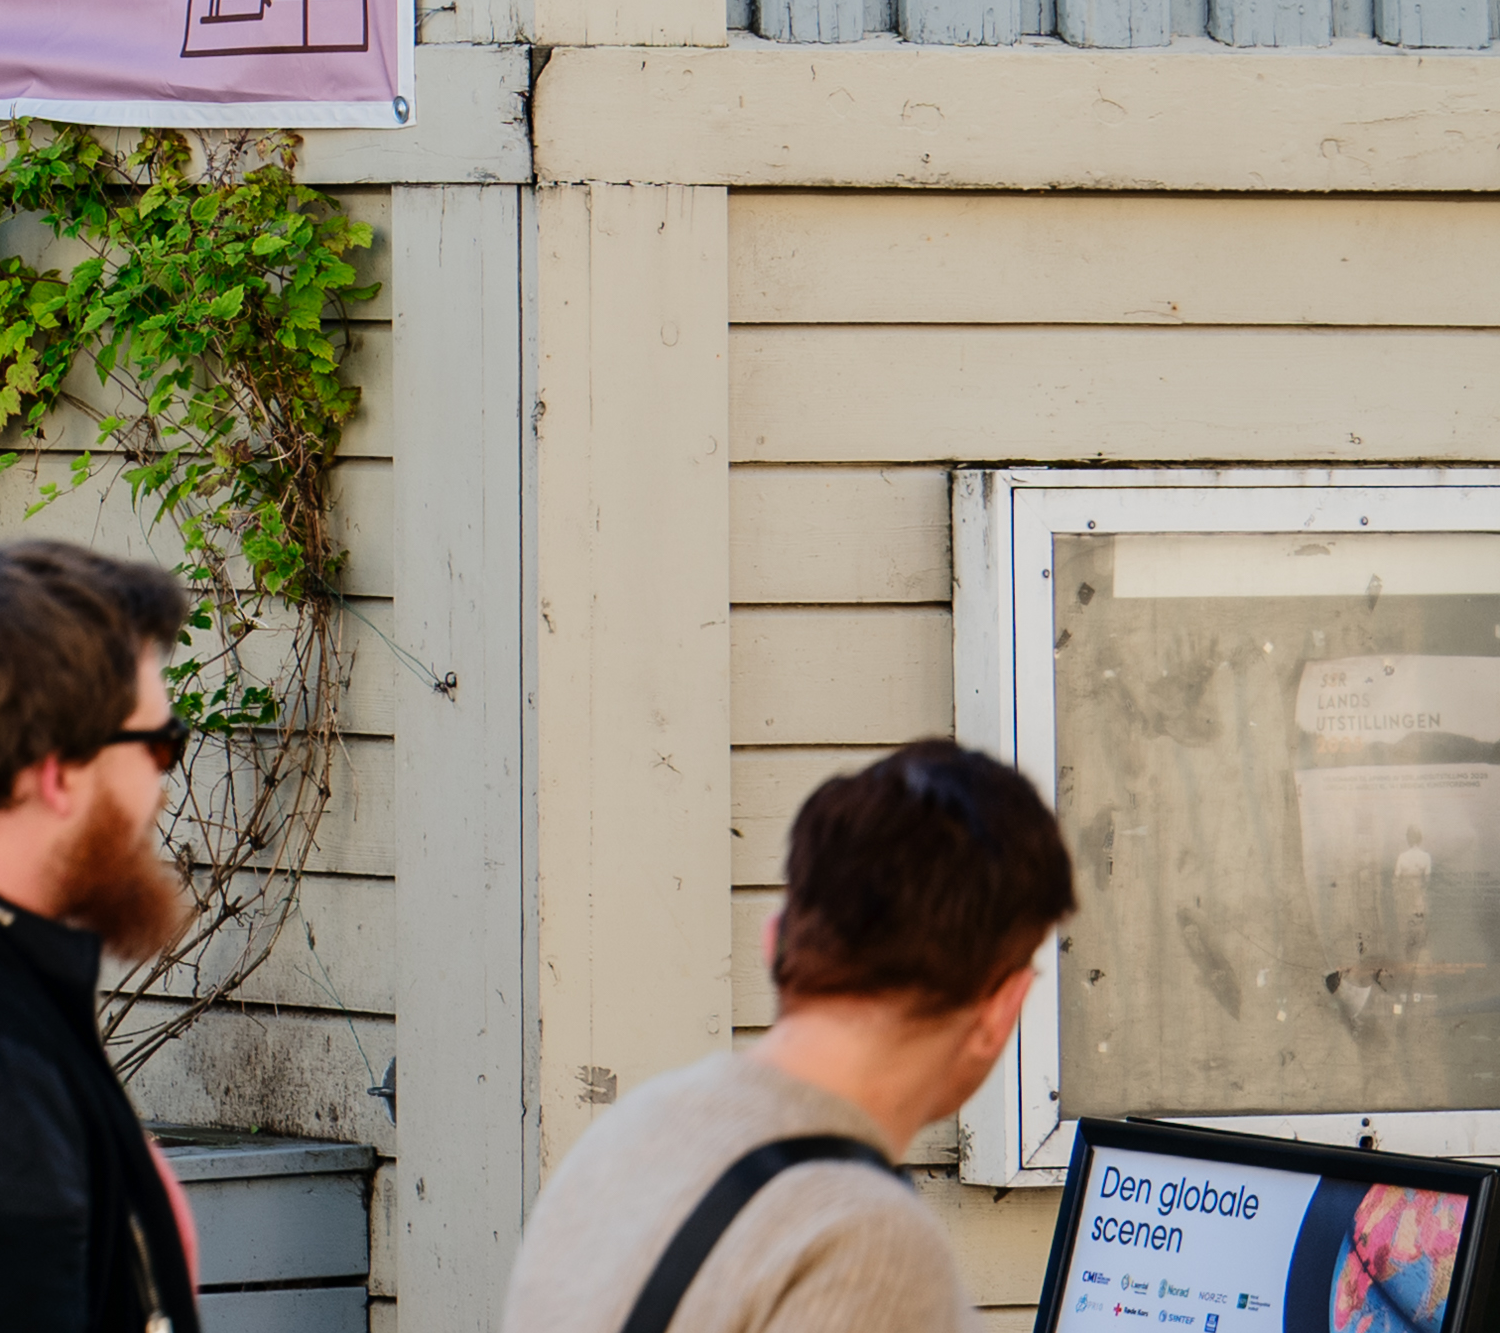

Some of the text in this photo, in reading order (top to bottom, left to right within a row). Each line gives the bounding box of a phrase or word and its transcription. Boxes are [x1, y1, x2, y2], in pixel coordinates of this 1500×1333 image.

[1320, 672, 1347, 688] SØR
[1317, 693, 1371, 710] LANDS
[1316, 713, 1441, 732] UTSTILLINGEN
[1100, 1165, 1260, 1221] Den globale
[1091, 1213, 1184, 1254] scenen
[1167, 1285, 1190, 1298] Norad
